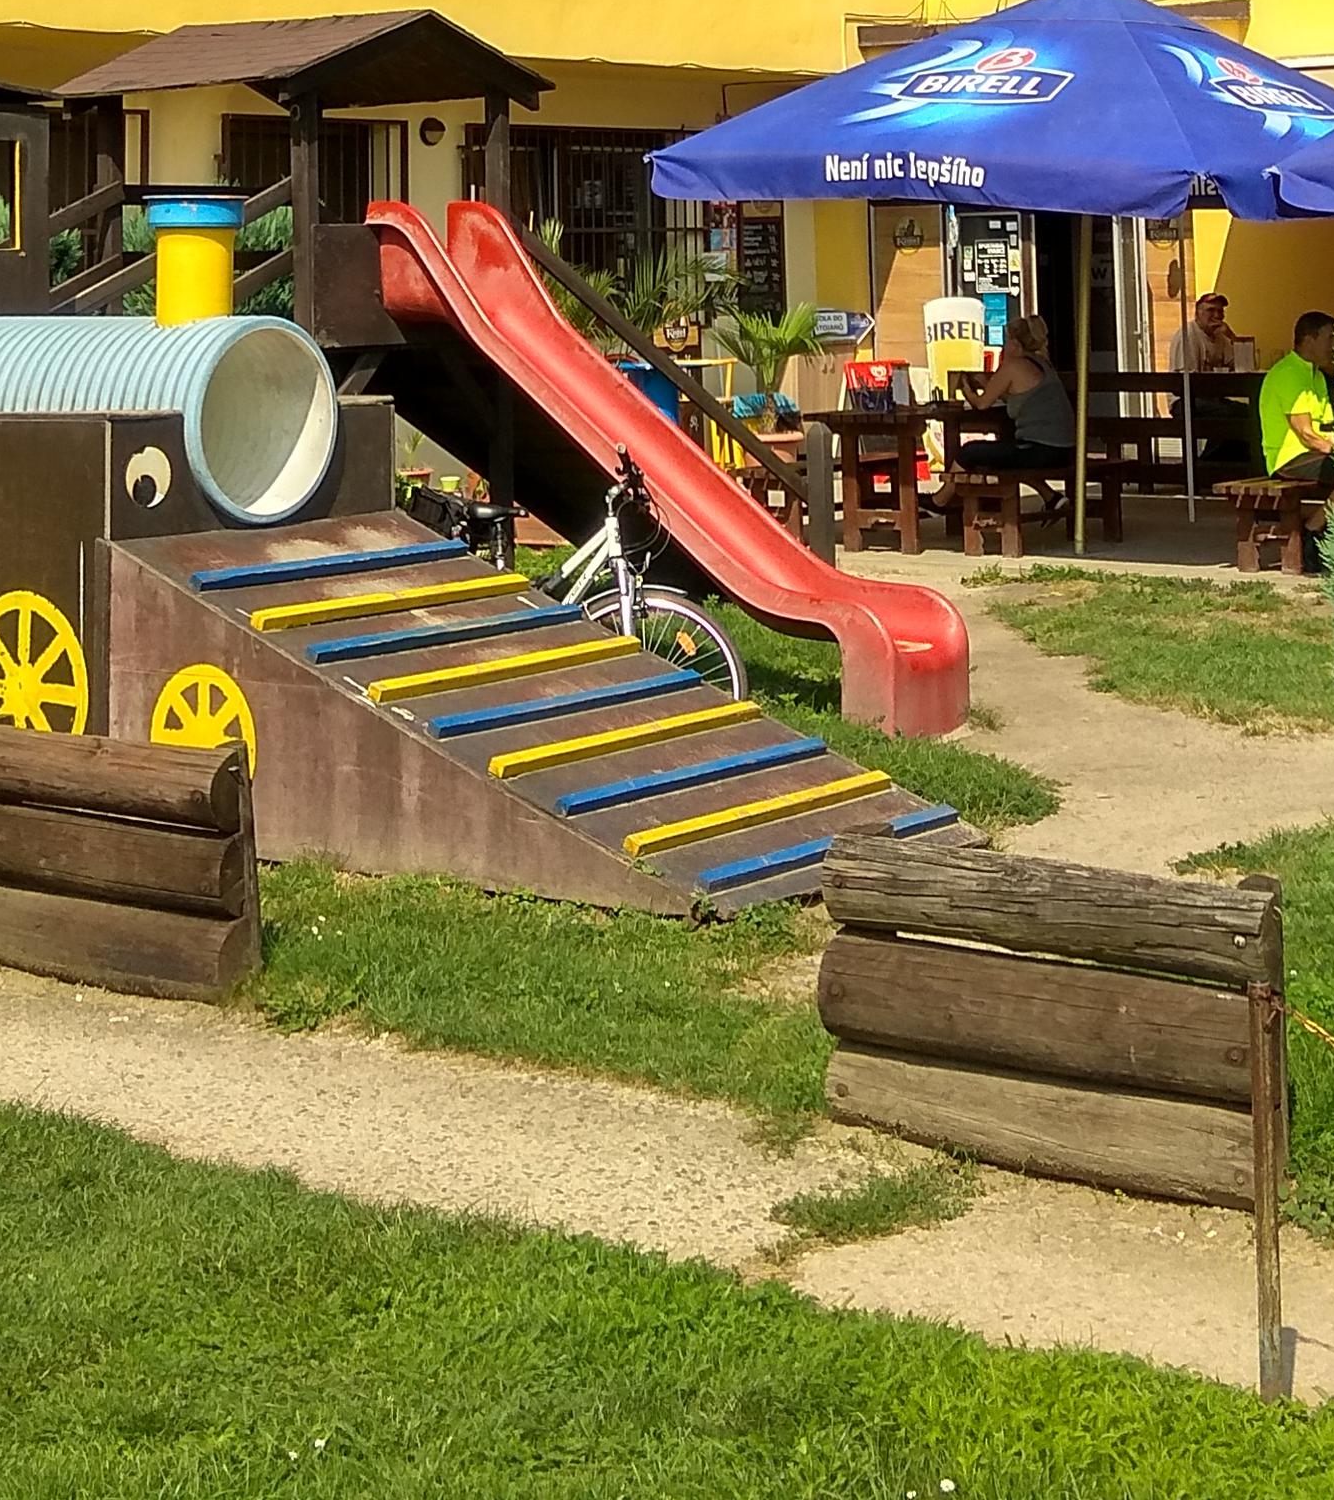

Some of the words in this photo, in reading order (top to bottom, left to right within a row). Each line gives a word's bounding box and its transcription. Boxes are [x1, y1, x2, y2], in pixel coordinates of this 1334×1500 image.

[913, 74, 1043, 96] BIRELL
[1226, 84, 1326, 112] BIRELL
[825, 153, 871, 182] Není
[873, 152, 905, 180] nic
[909, 151, 986, 188] lepšího
